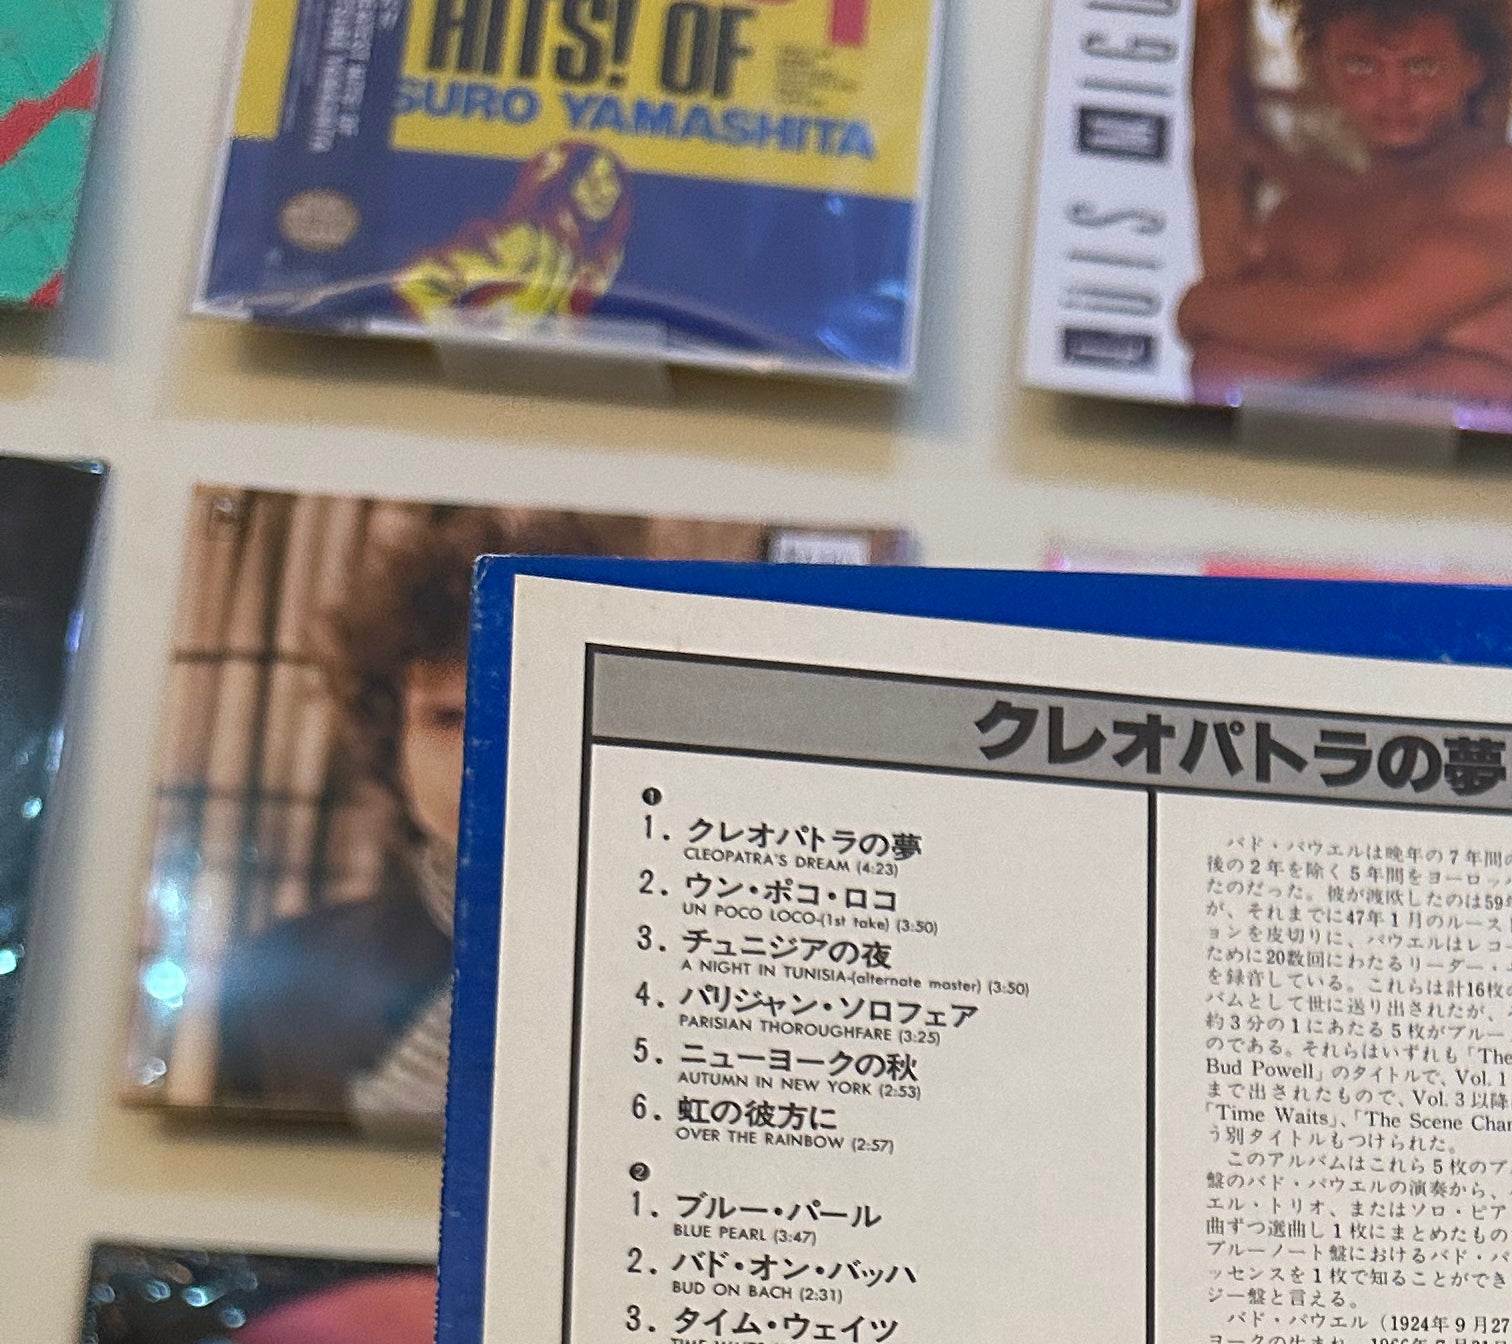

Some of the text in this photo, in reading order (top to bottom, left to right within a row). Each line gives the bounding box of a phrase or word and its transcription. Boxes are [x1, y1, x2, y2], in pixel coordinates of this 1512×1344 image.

[659, 1, 760, 101] OF
[687, 817, 923, 861] クレオパトラの夢
[683, 846, 899, 879] CLEOPATRA'S DREAM (4:23)
[684, 871, 898, 912] ウン・ポコ・ロコ
[682, 901, 707, 916] UN
[714, 903, 763, 921] POCO
[853, 916, 890, 933] take)
[895, 918, 939, 937] (3:50)
[680, 927, 892, 969] チュニジアの夜
[680, 958, 693, 971] A
[699, 959, 752, 976] NIGHT
[758, 963, 776, 977] IN
[928, 978, 982, 995] master)
[987, 980, 1030, 998] (3:50)
[680, 983, 979, 1028] パリジャン・ソロフェア
[678, 1013, 941, 1047] PARISIAN THOROUGHFARE (3:25)
[680, 1039, 918, 1083] ニューヨークの秋
[677, 1071, 922, 1101] AUTUMN IN NEW YORK (2:53)
[676, 1095, 838, 1132] 虹の彼方に
[674, 1126, 894, 1156] OVER THE RAINBOW (2:57)
[675, 1190, 883, 1230] ブルー・パール
[673, 1223, 817, 1247] BLUE PEARL (3:47)
[670, 1250, 918, 1287] バド・オン・バッハ
[671, 1280, 843, 1305] BUD ON BACH (2:31)
[673, 1306, 900, 1344] タイム・ウェイツ
